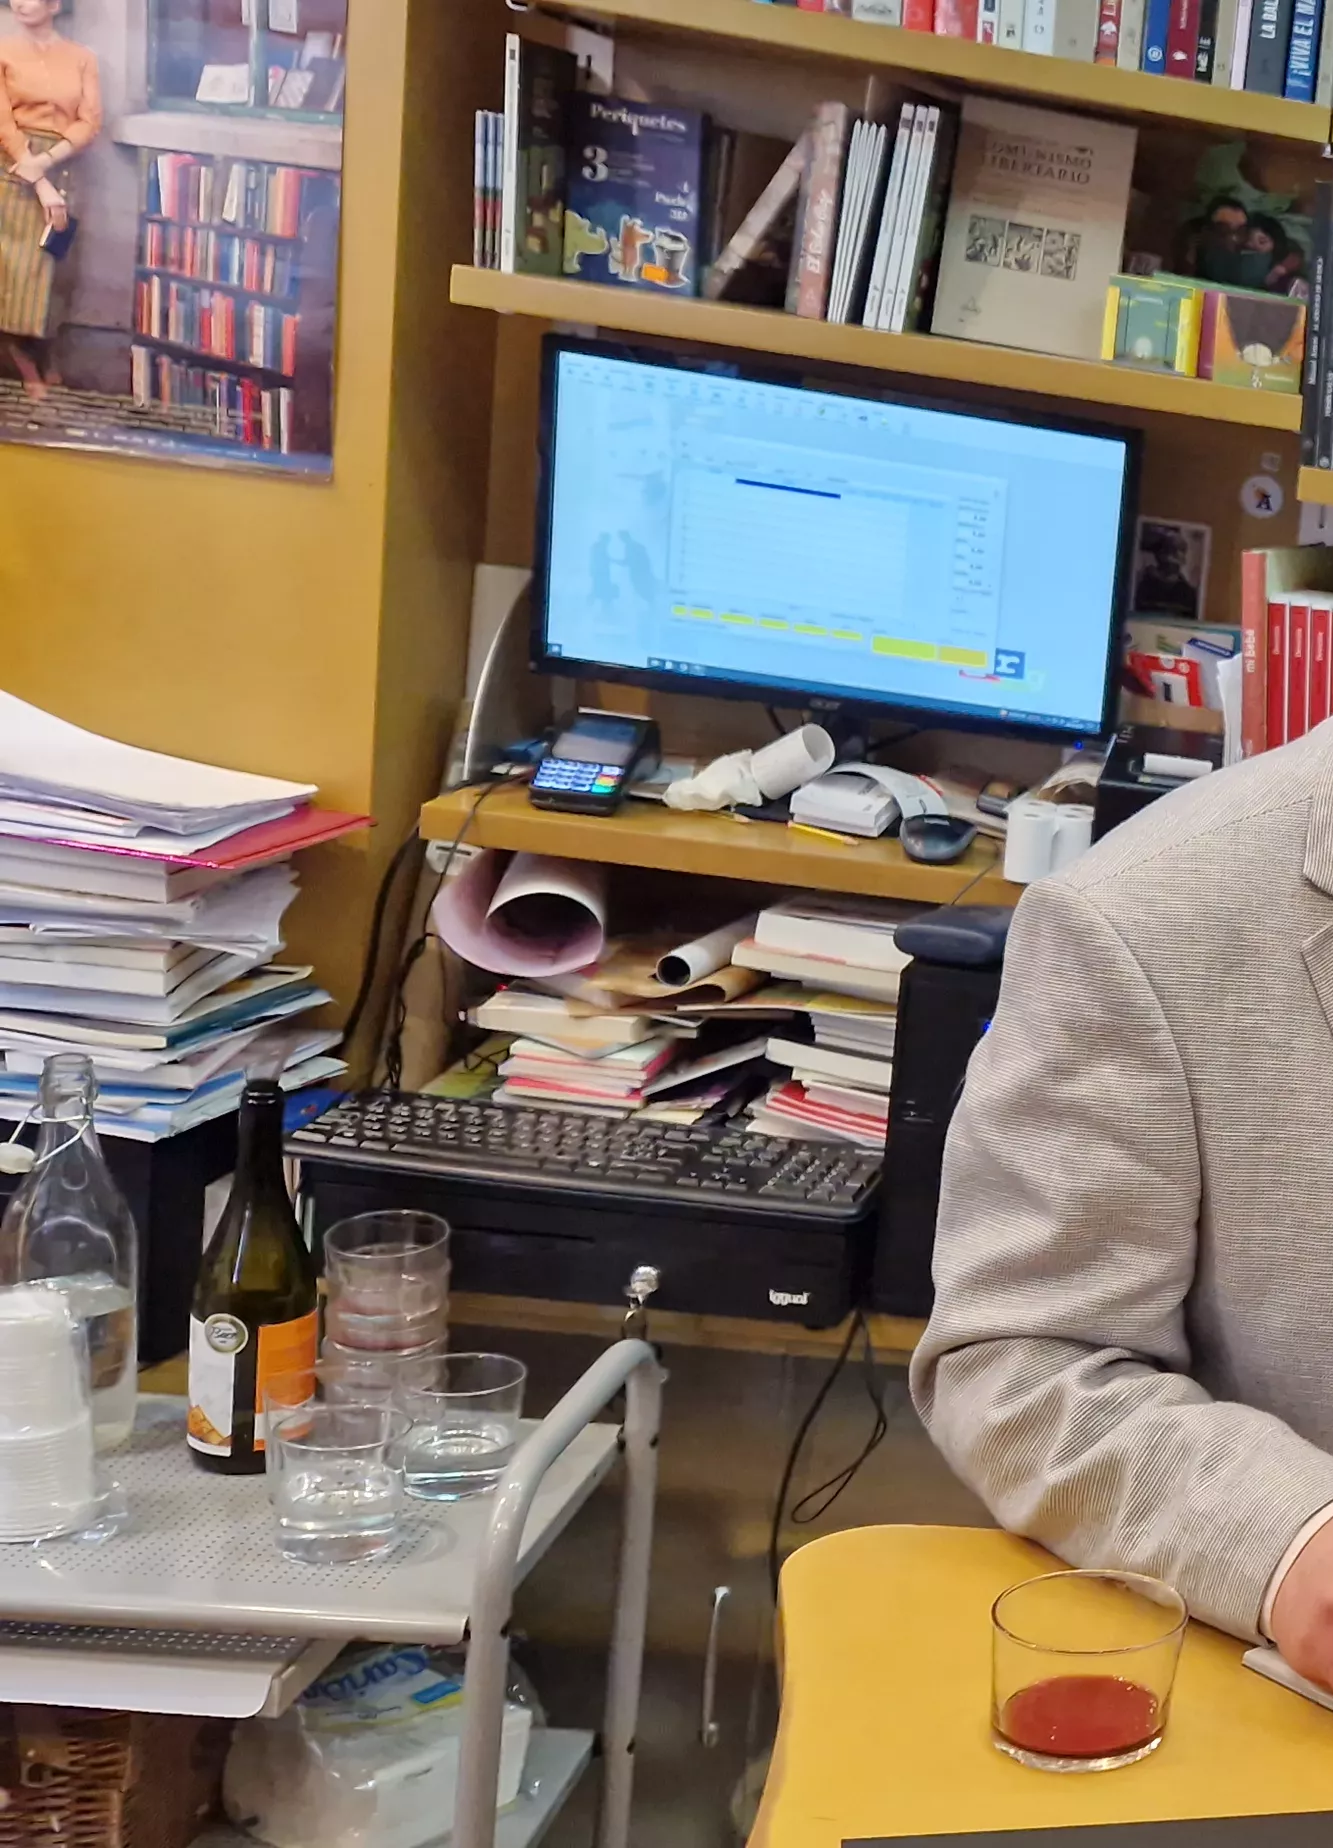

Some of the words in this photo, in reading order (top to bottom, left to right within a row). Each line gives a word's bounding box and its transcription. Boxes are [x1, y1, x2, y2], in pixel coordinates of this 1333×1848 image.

[1259, 22, 1277, 39] LA
[1293, 18, 1314, 35] EL
[1289, 38, 1315, 76] ¡VIVA
[590, 103, 687, 137] Periquetes
[582, 145, 609, 182] 3
